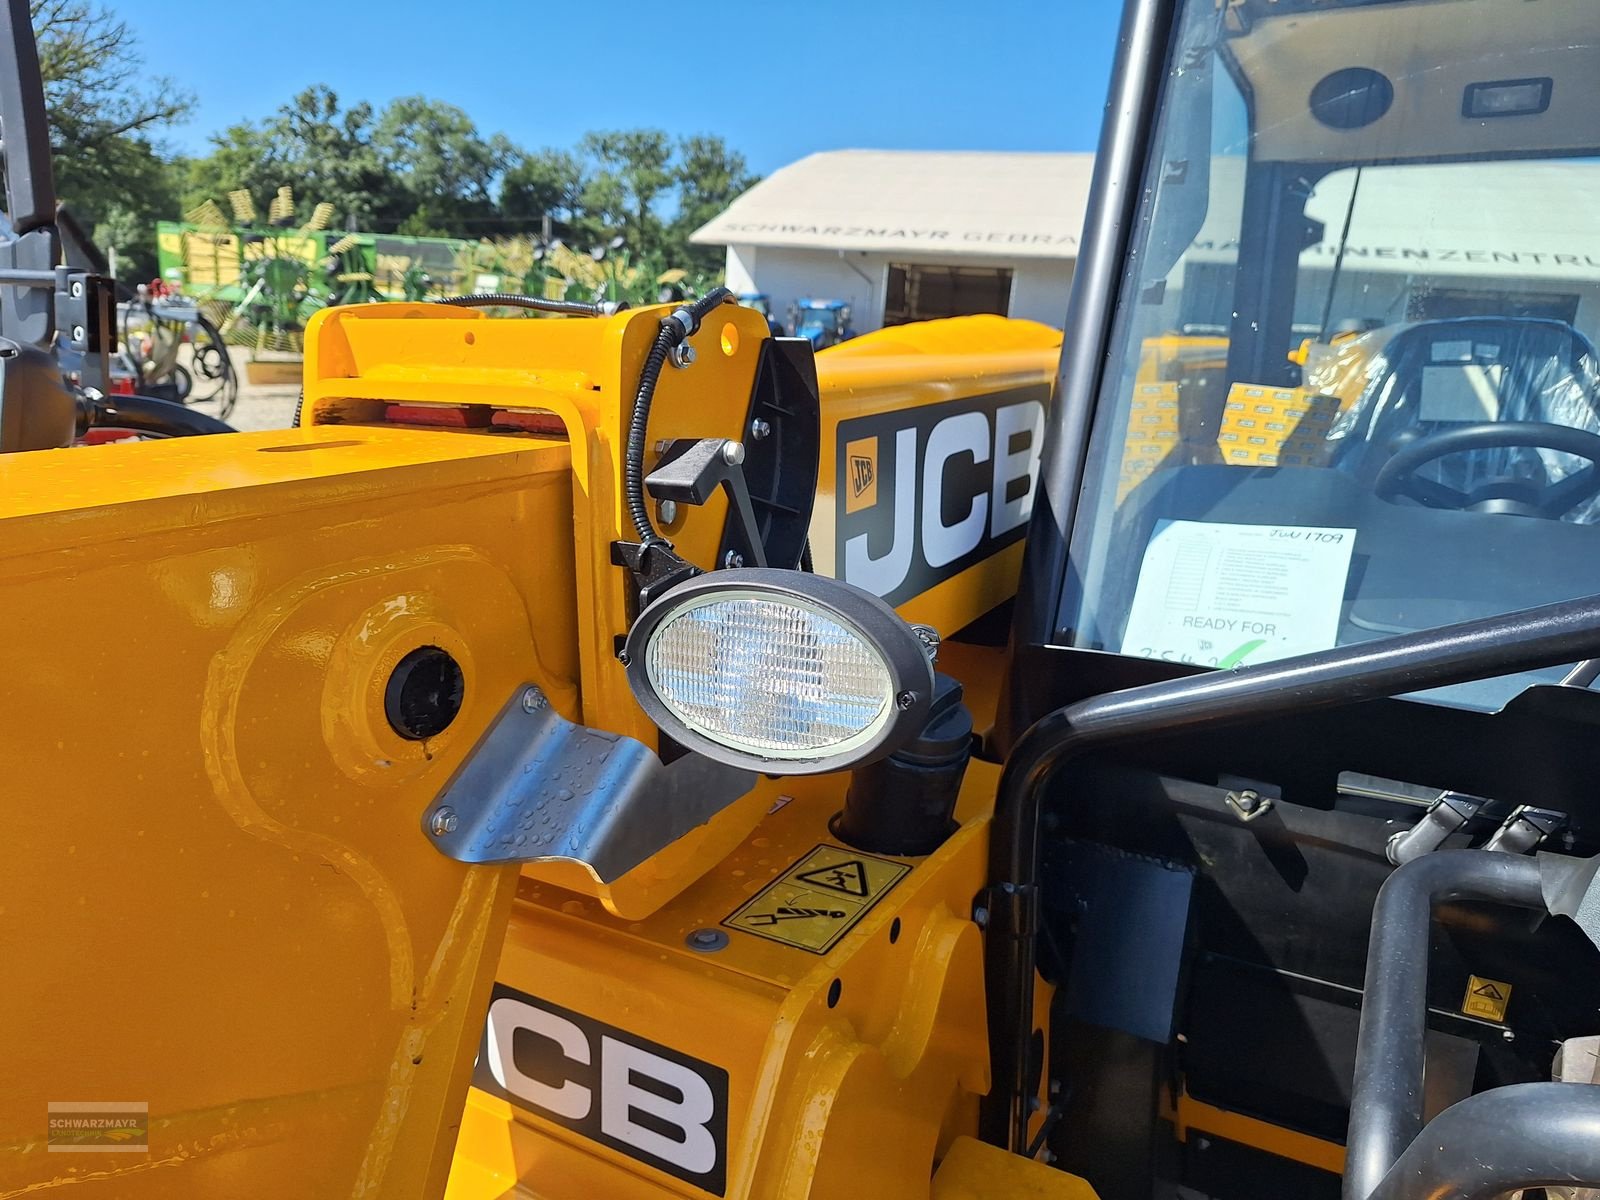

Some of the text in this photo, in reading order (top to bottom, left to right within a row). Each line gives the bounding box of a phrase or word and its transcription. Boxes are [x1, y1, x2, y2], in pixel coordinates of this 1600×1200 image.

[721, 223, 950, 240] SCHWARZMAYR
[964, 231, 1076, 245] GEBRA
[854, 459, 873, 492] JCB
[846, 400, 1045, 598] JCB
[1182, 615, 1277, 636] READY FOR
[474, 998, 717, 1175] CB
